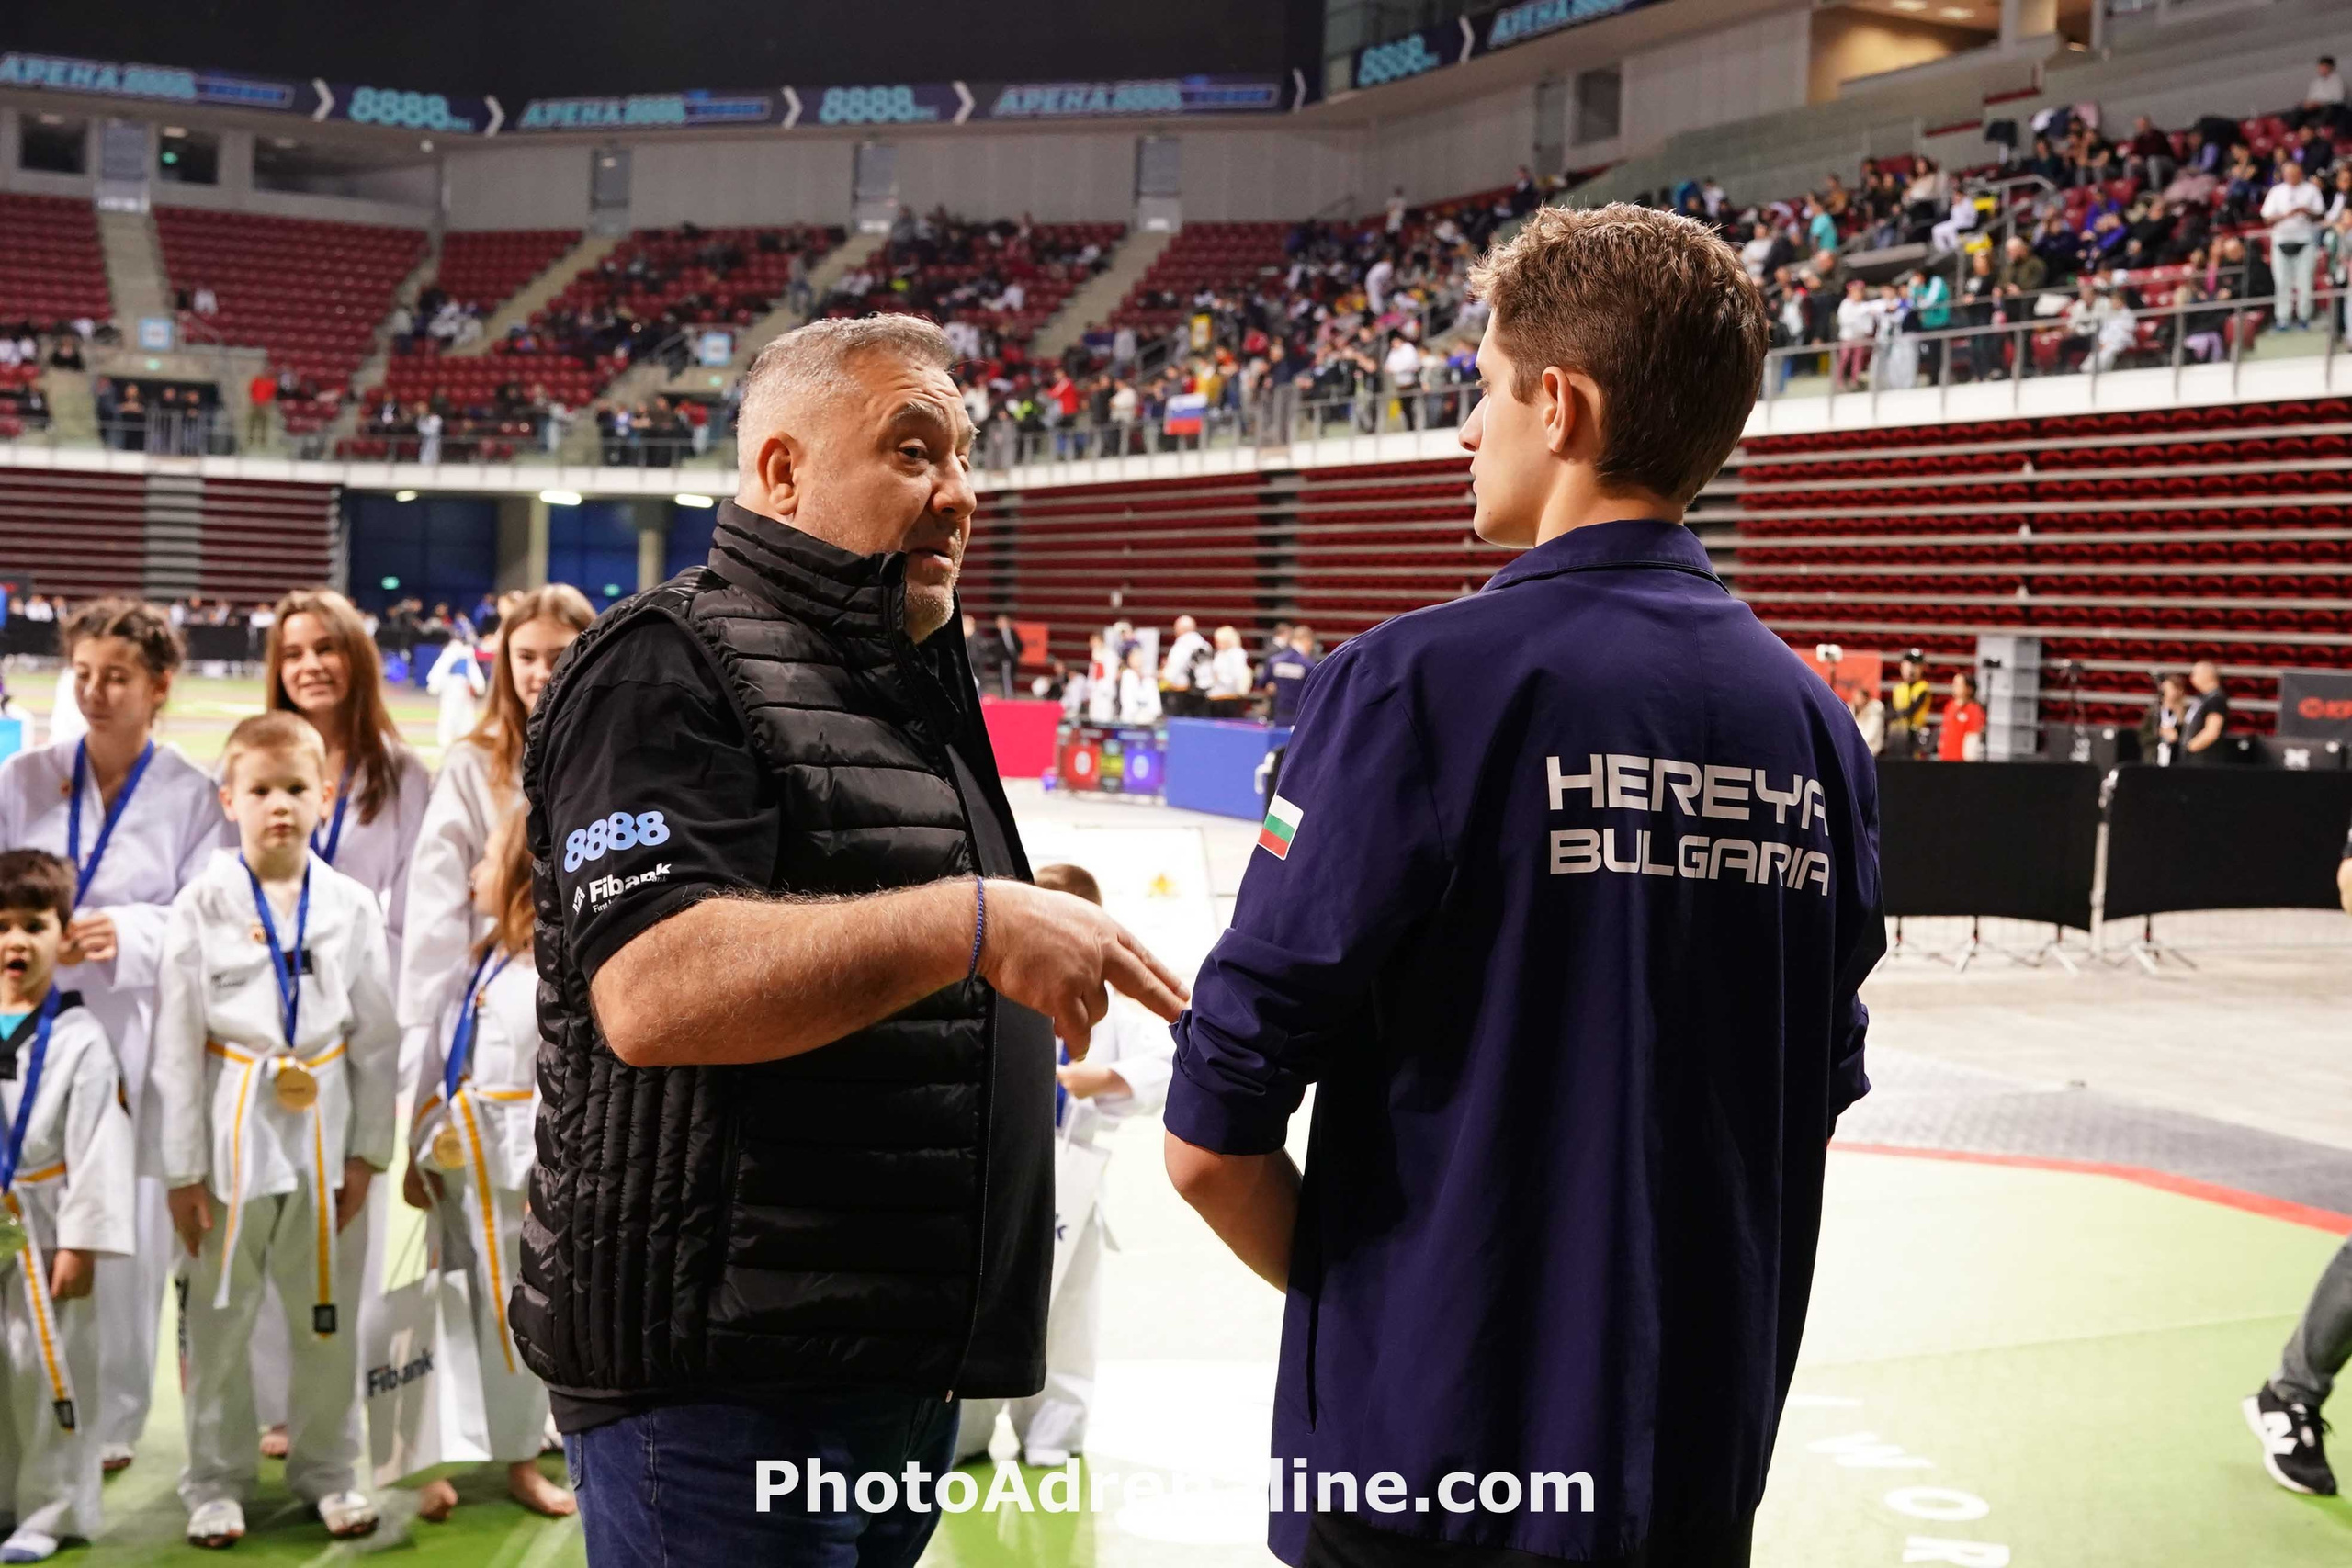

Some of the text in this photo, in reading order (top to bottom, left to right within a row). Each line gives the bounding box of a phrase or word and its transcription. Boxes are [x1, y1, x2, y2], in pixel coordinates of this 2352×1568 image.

[1546, 753, 1828, 836] HEREYA
[564, 811, 670, 873] 8888
[1550, 828, 1829, 896] BULGARIA
[589, 863, 672, 903] Fibank
